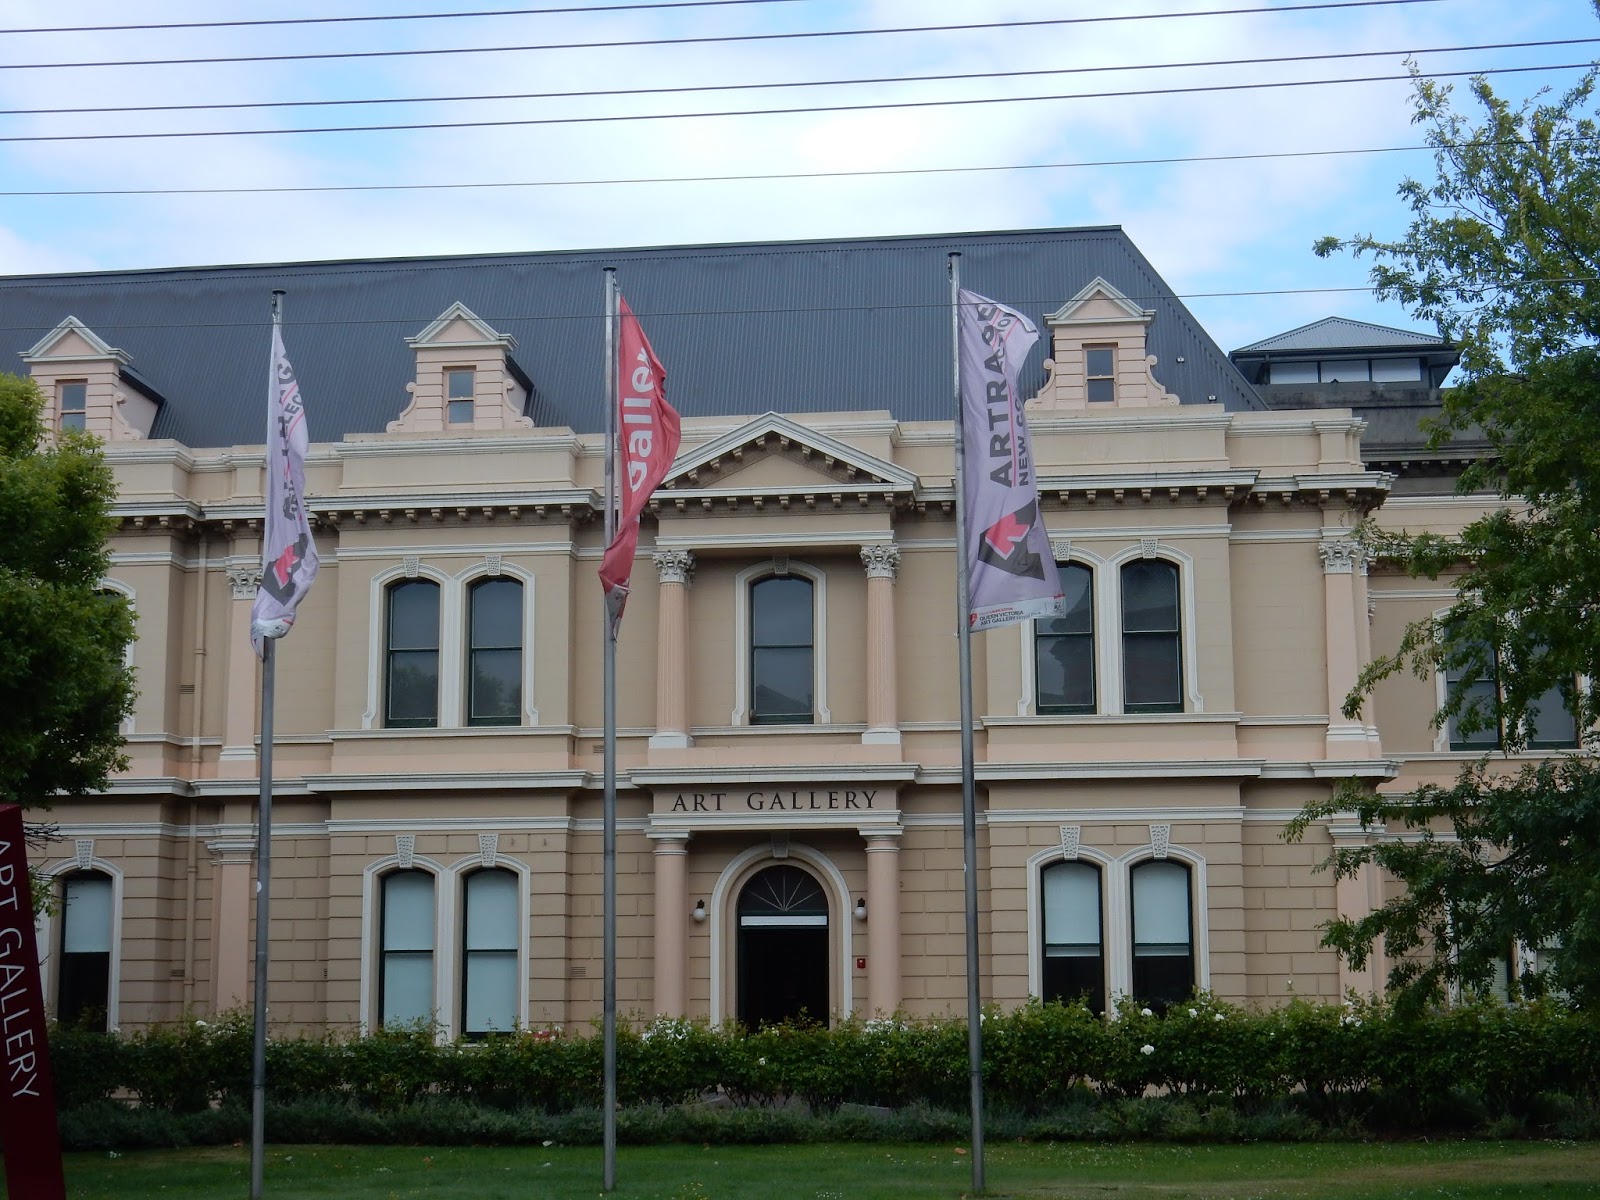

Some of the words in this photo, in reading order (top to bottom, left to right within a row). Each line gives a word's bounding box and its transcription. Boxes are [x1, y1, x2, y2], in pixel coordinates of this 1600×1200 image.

[1018, 435, 1028, 486] NEW
[979, 613, 998, 621] QUEEN
[999, 610, 1024, 618] VICTORIA
[992, 615, 1016, 624] GALLERY
[671, 793, 726, 812] ART
[746, 790, 878, 810] GALLERY
[0, 927, 40, 1097] GALLERY
